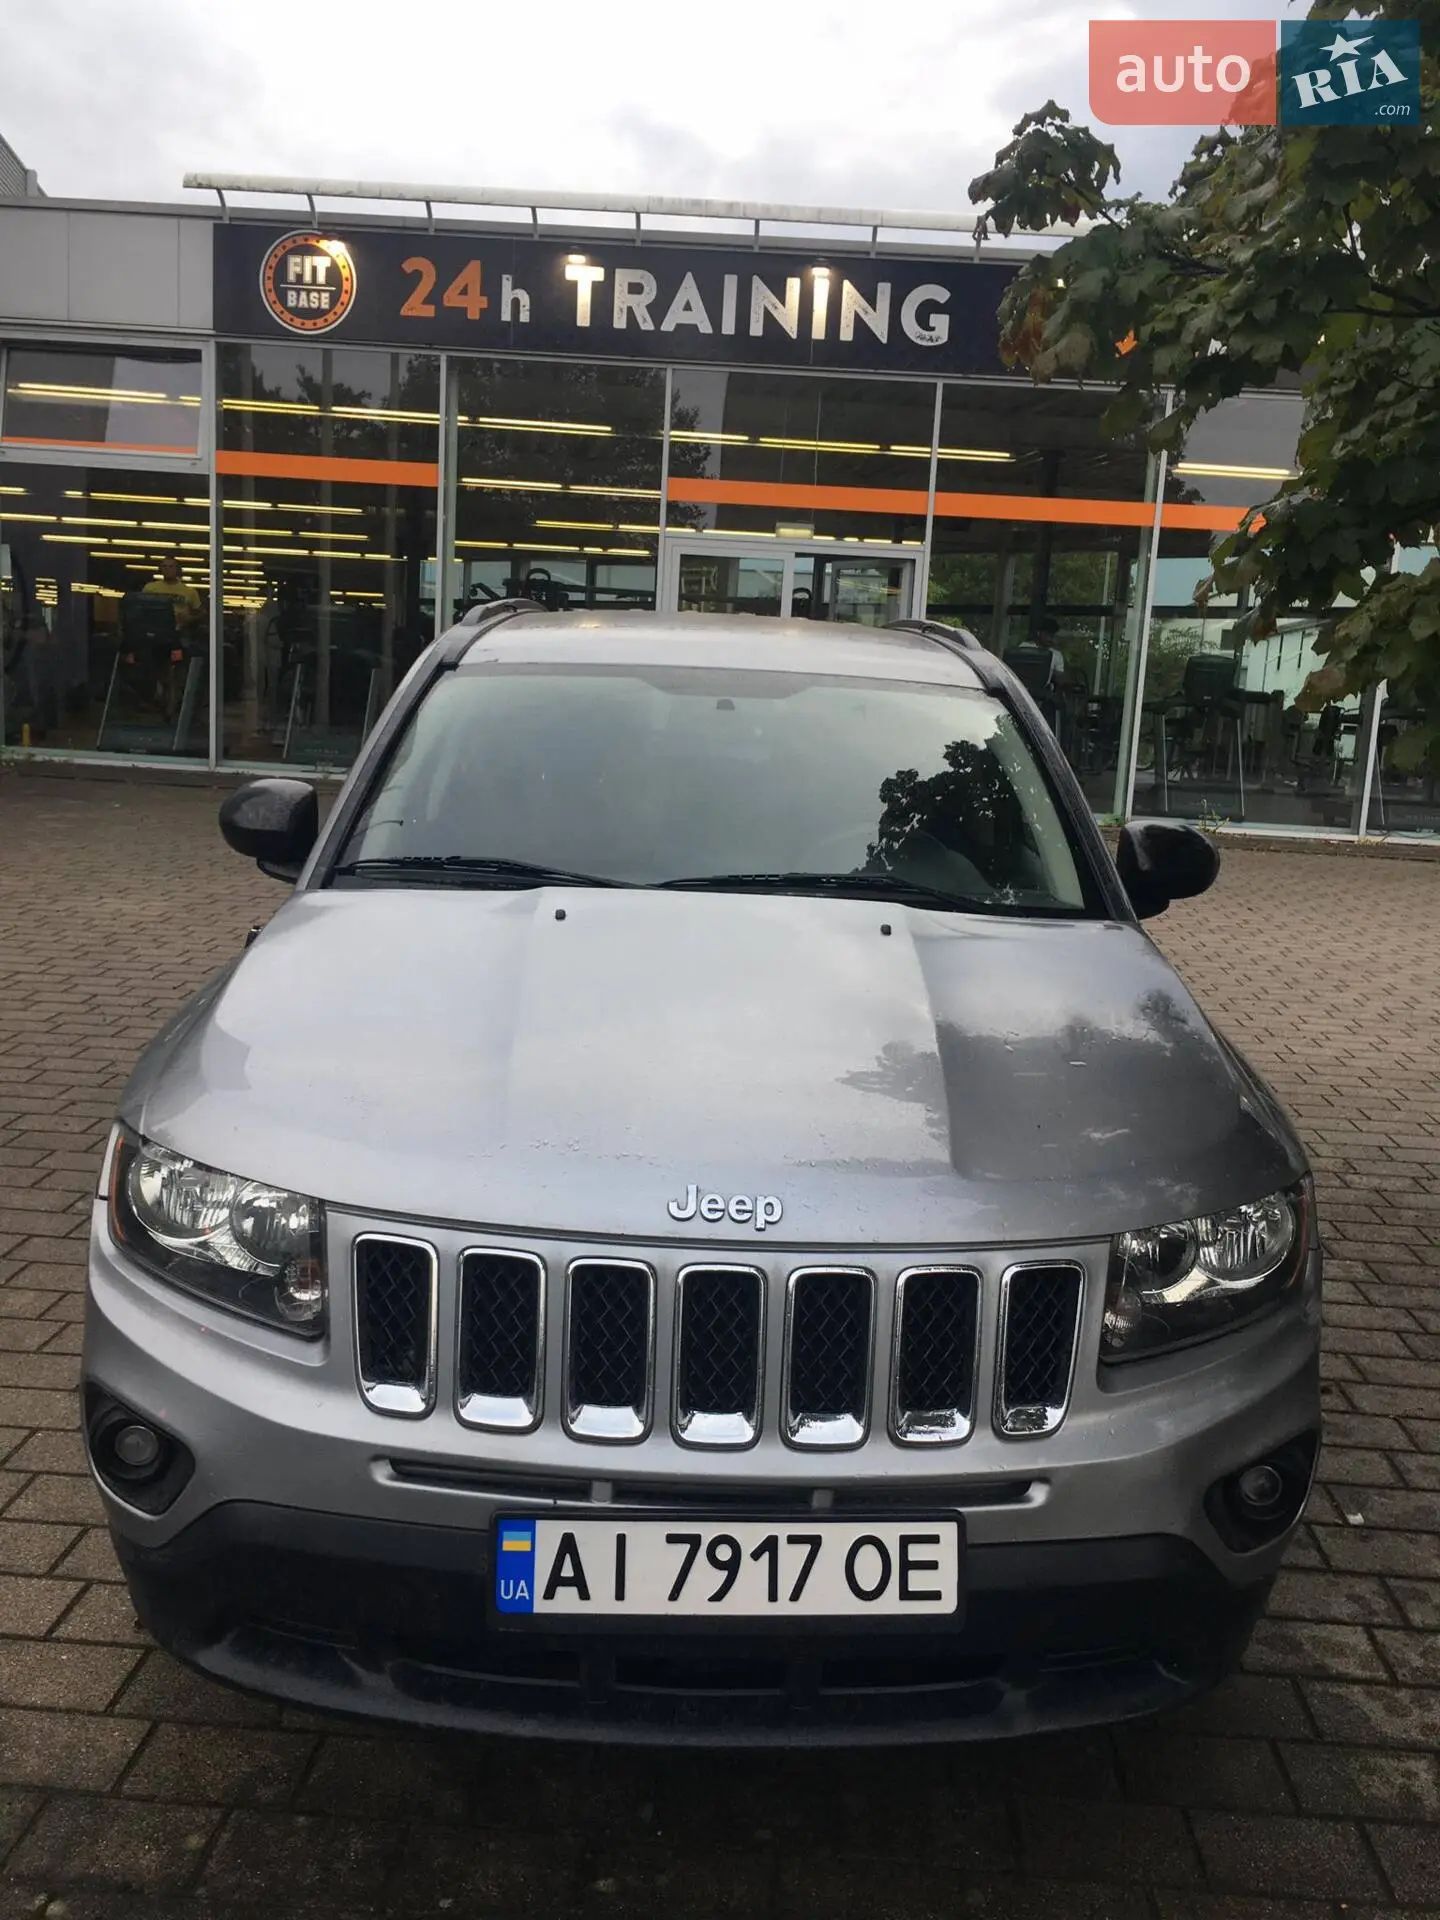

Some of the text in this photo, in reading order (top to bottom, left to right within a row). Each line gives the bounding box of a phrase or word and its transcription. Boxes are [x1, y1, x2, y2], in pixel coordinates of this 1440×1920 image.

[286, 255, 331, 285] FIT
[286, 290, 330, 310] BASE
[565, 264, 952, 347] TRAINING
[667, 1184, 784, 1232] Jeep
[665, 1533, 823, 1602] 7917
[844, 1534, 943, 1602] OE
[499, 1579, 530, 1600] UA
